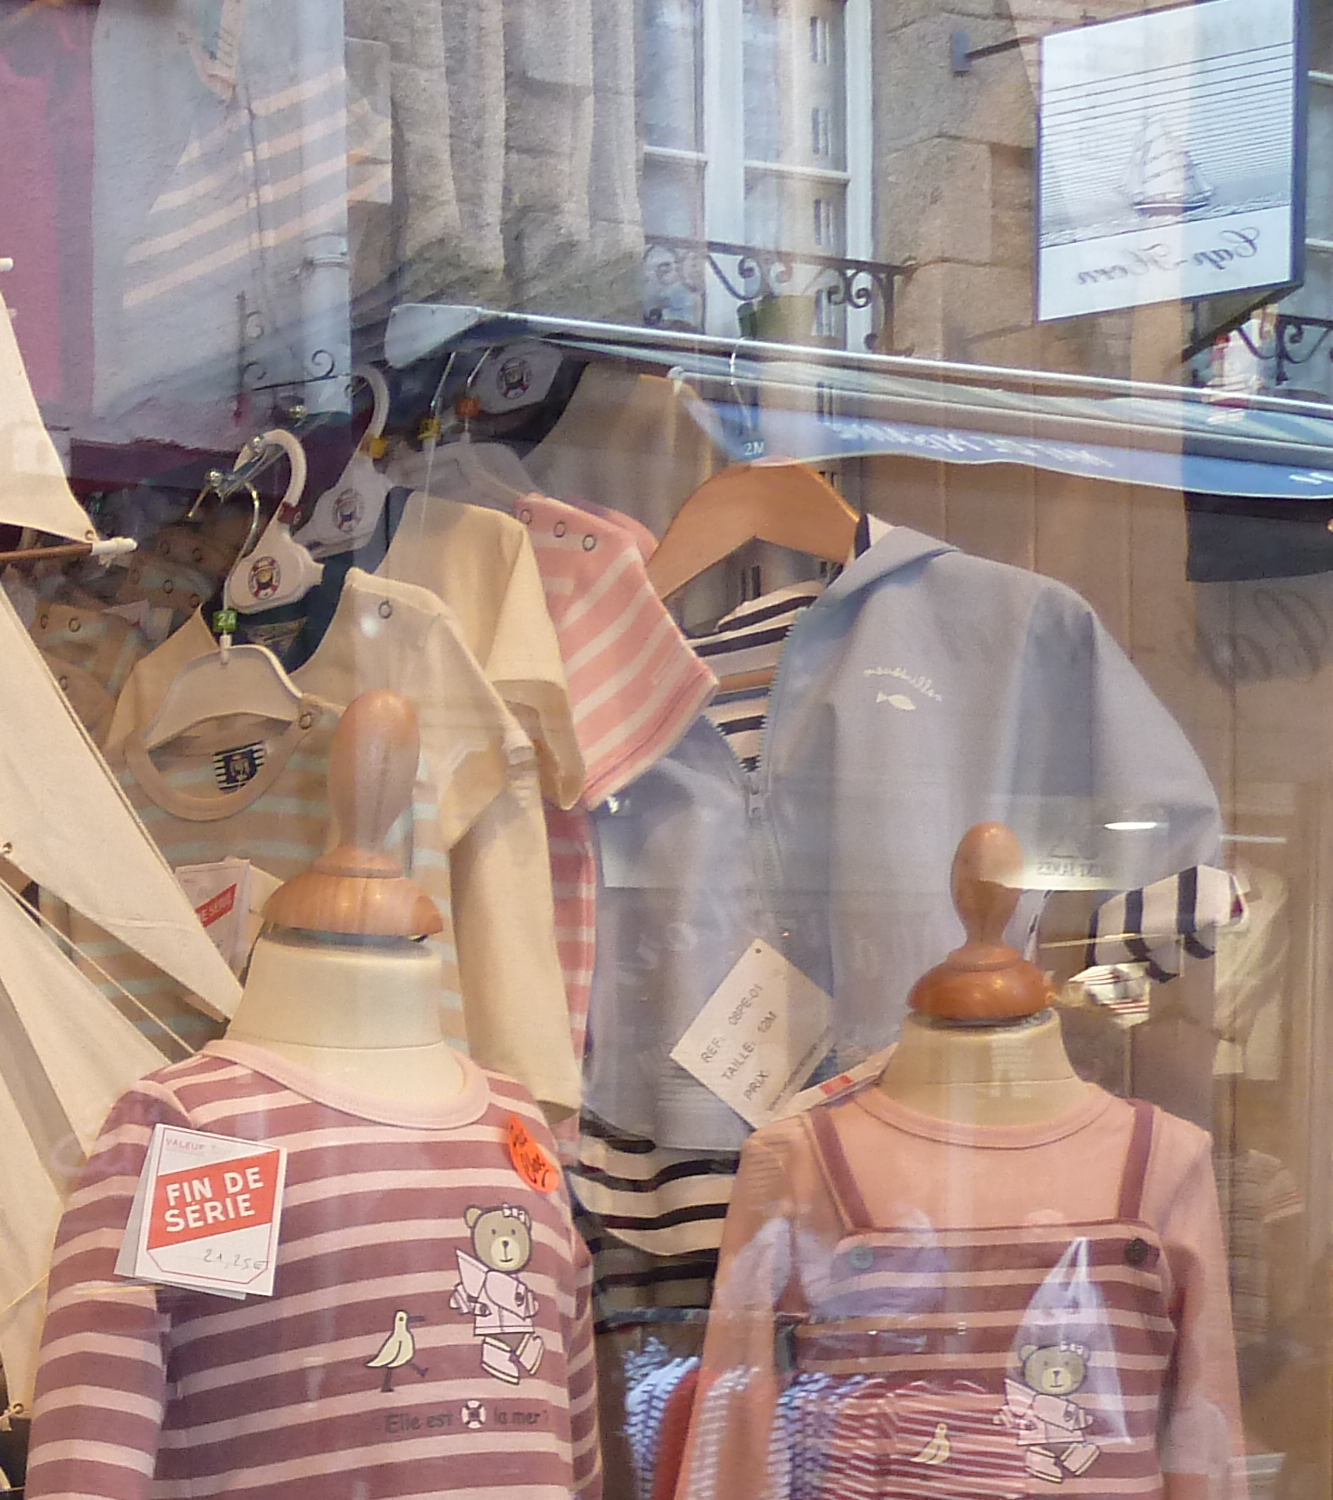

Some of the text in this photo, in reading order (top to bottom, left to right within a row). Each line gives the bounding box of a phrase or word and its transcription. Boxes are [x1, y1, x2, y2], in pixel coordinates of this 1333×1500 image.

[166, 1166, 264, 1206] FIN DE
[164, 1193, 256, 1233] SÉRIE
